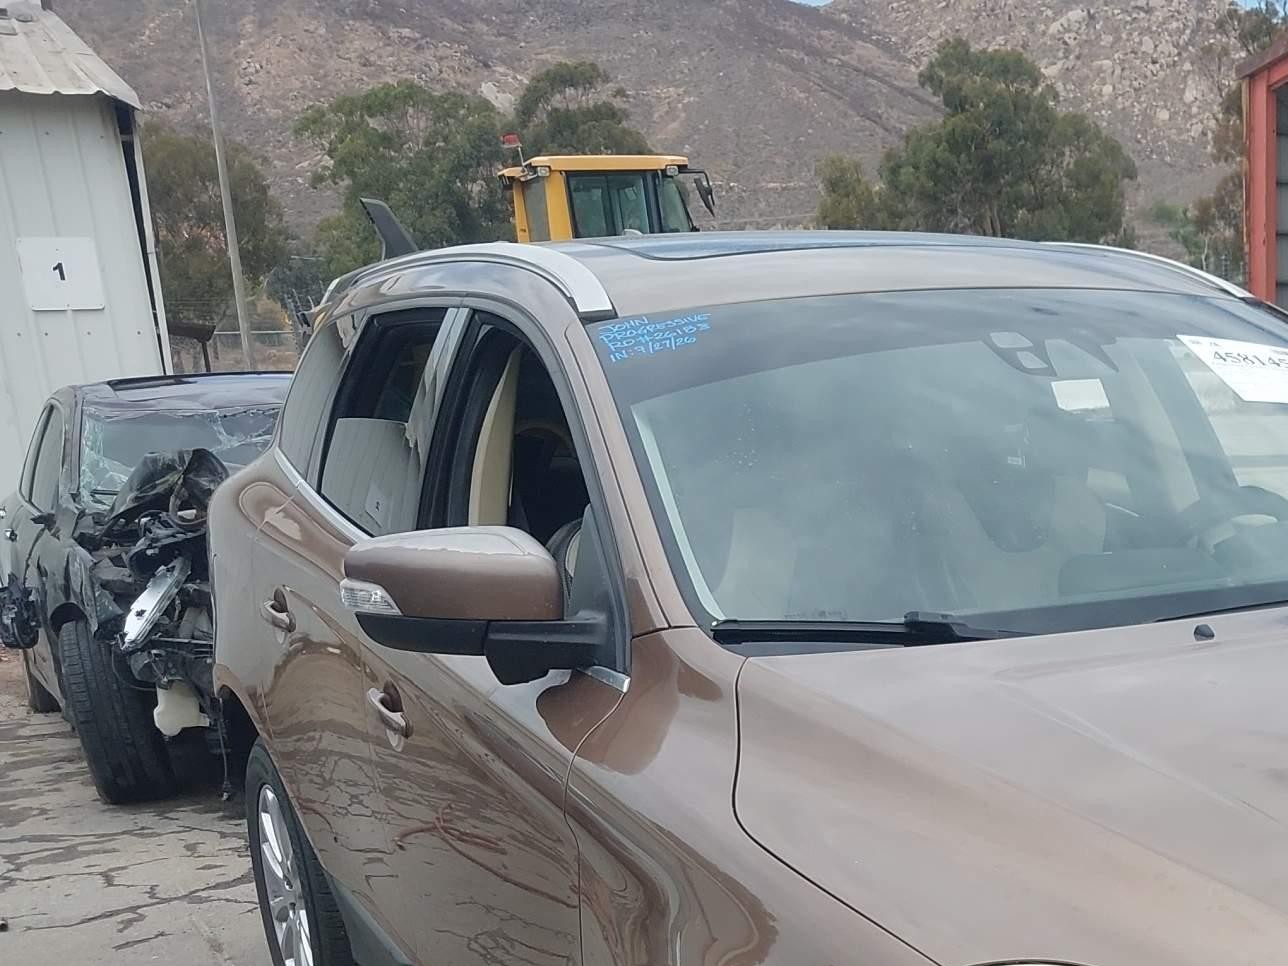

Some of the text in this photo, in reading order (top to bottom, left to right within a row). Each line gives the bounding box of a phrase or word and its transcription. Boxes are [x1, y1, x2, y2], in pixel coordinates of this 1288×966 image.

[52, 262, 66, 281] 1
[598, 316, 649, 332] JOHN
[599, 313, 712, 344] PROGRESSIVE
